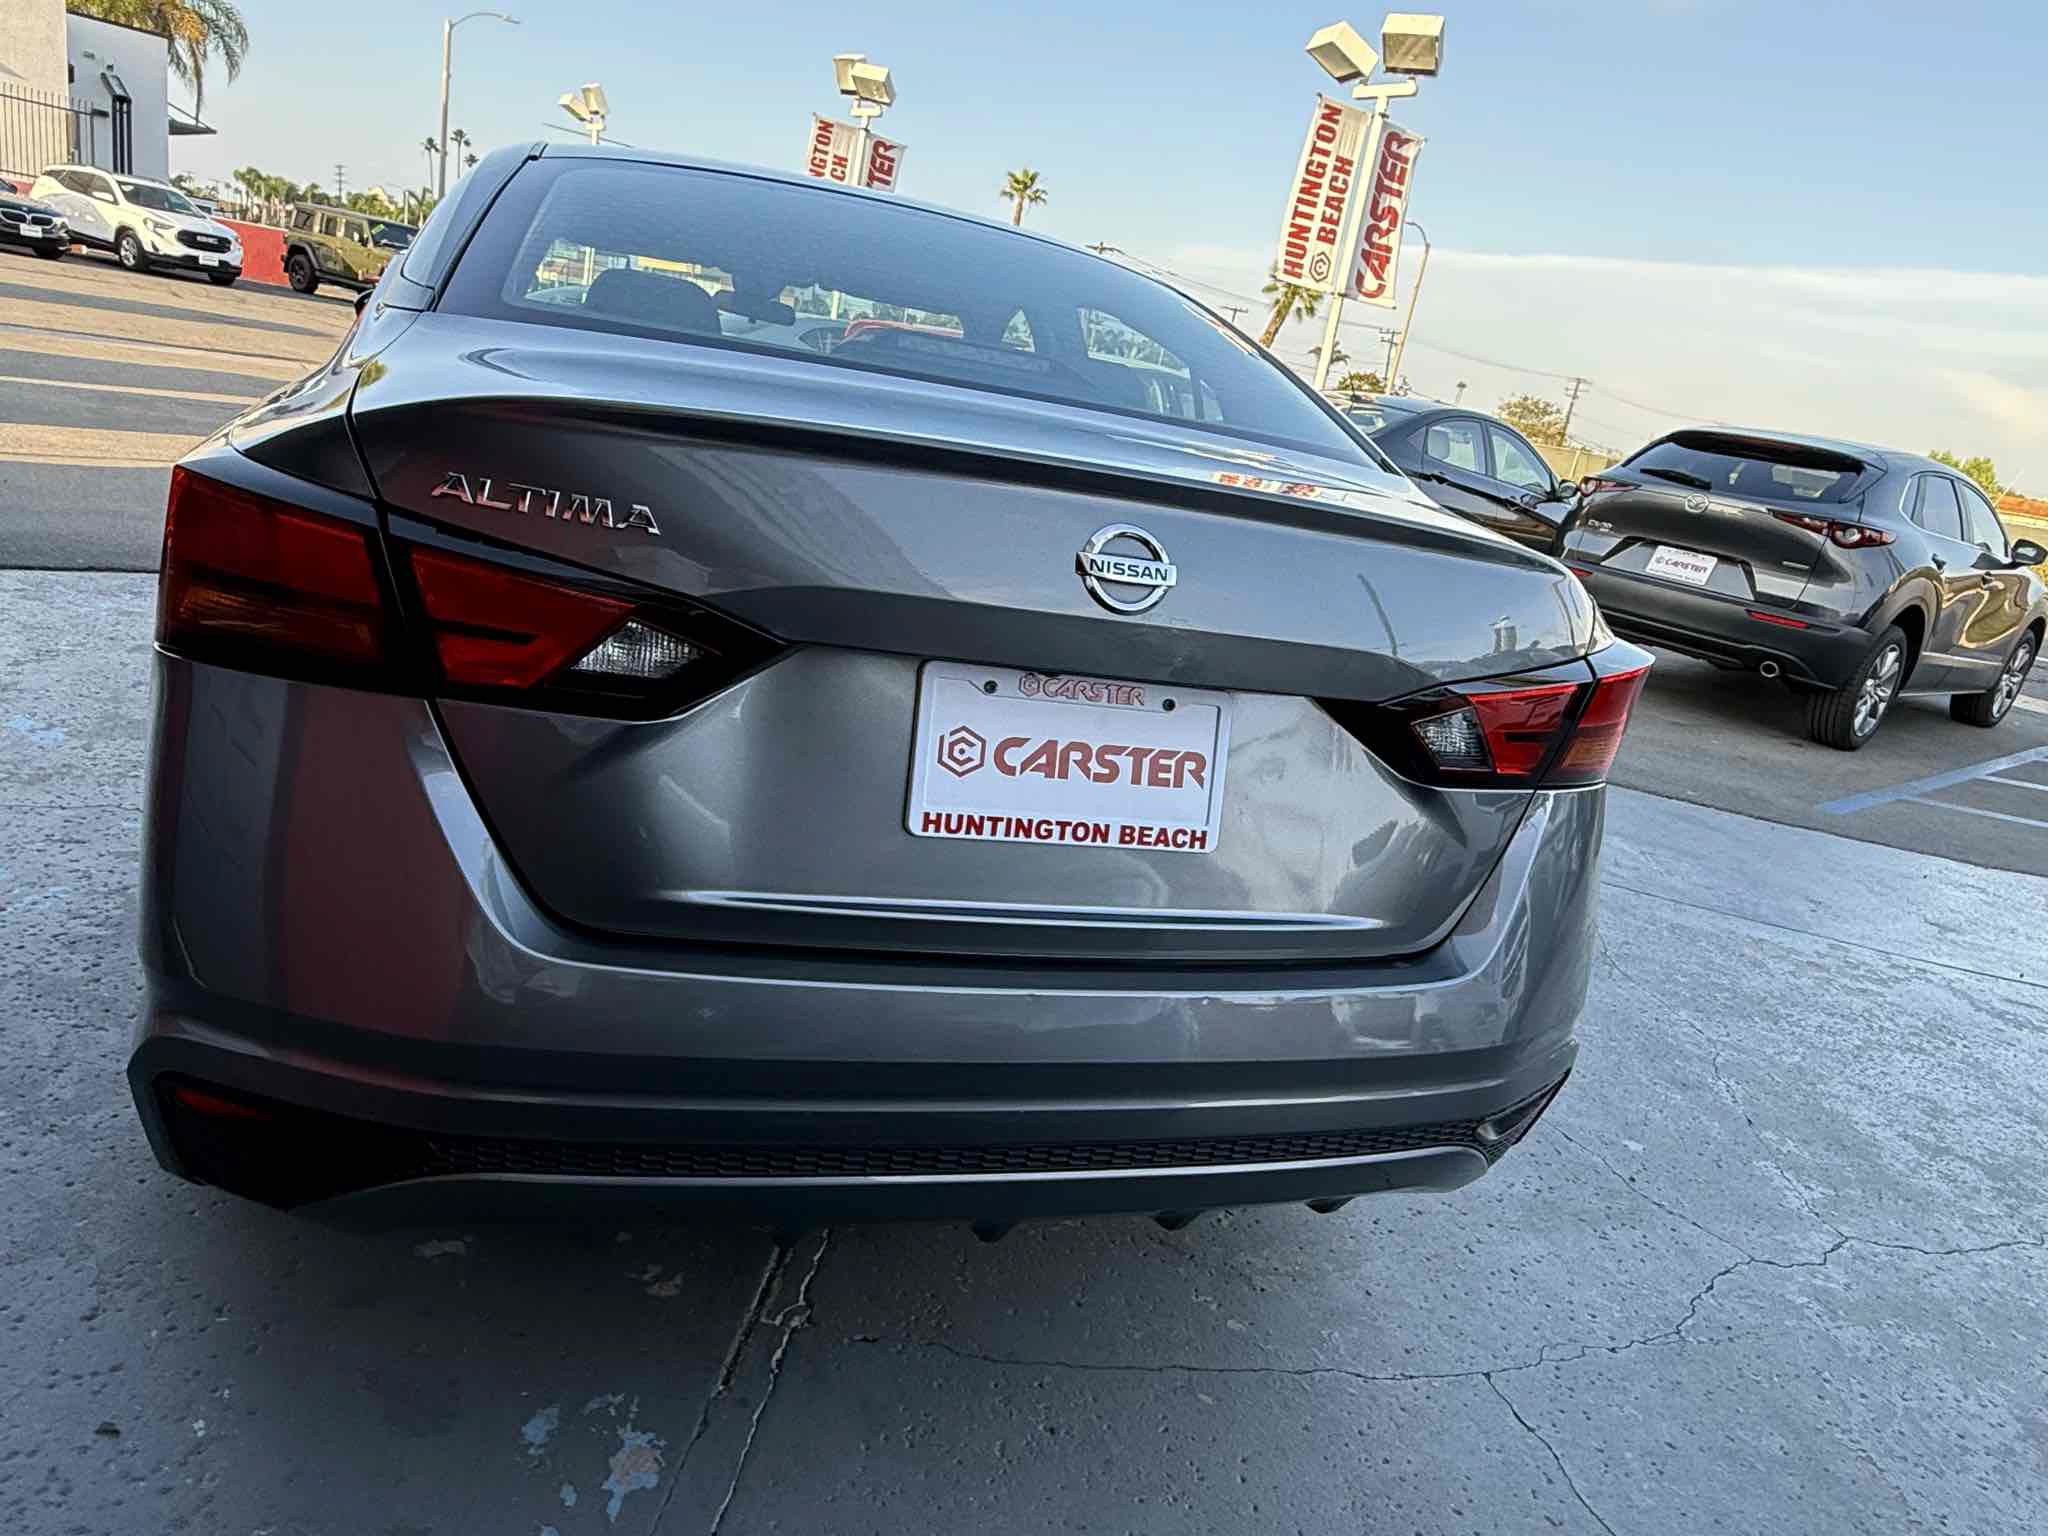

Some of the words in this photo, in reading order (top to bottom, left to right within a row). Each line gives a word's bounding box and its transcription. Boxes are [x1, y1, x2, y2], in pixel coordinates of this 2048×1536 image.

[1283, 104, 1342, 279] HUNTINGTON
[1316, 155, 1354, 246] BEACH
[1355, 131, 1418, 298] CARSTER
[431, 471, 661, 536] ALTIMA
[1089, 558, 1169, 581] NISSAN
[1043, 677, 1145, 706] CARSTER
[993, 736, 1207, 789] CARSTER
[921, 811, 1110, 844] HUNTINGTON
[1118, 824, 1208, 850] BEACH
